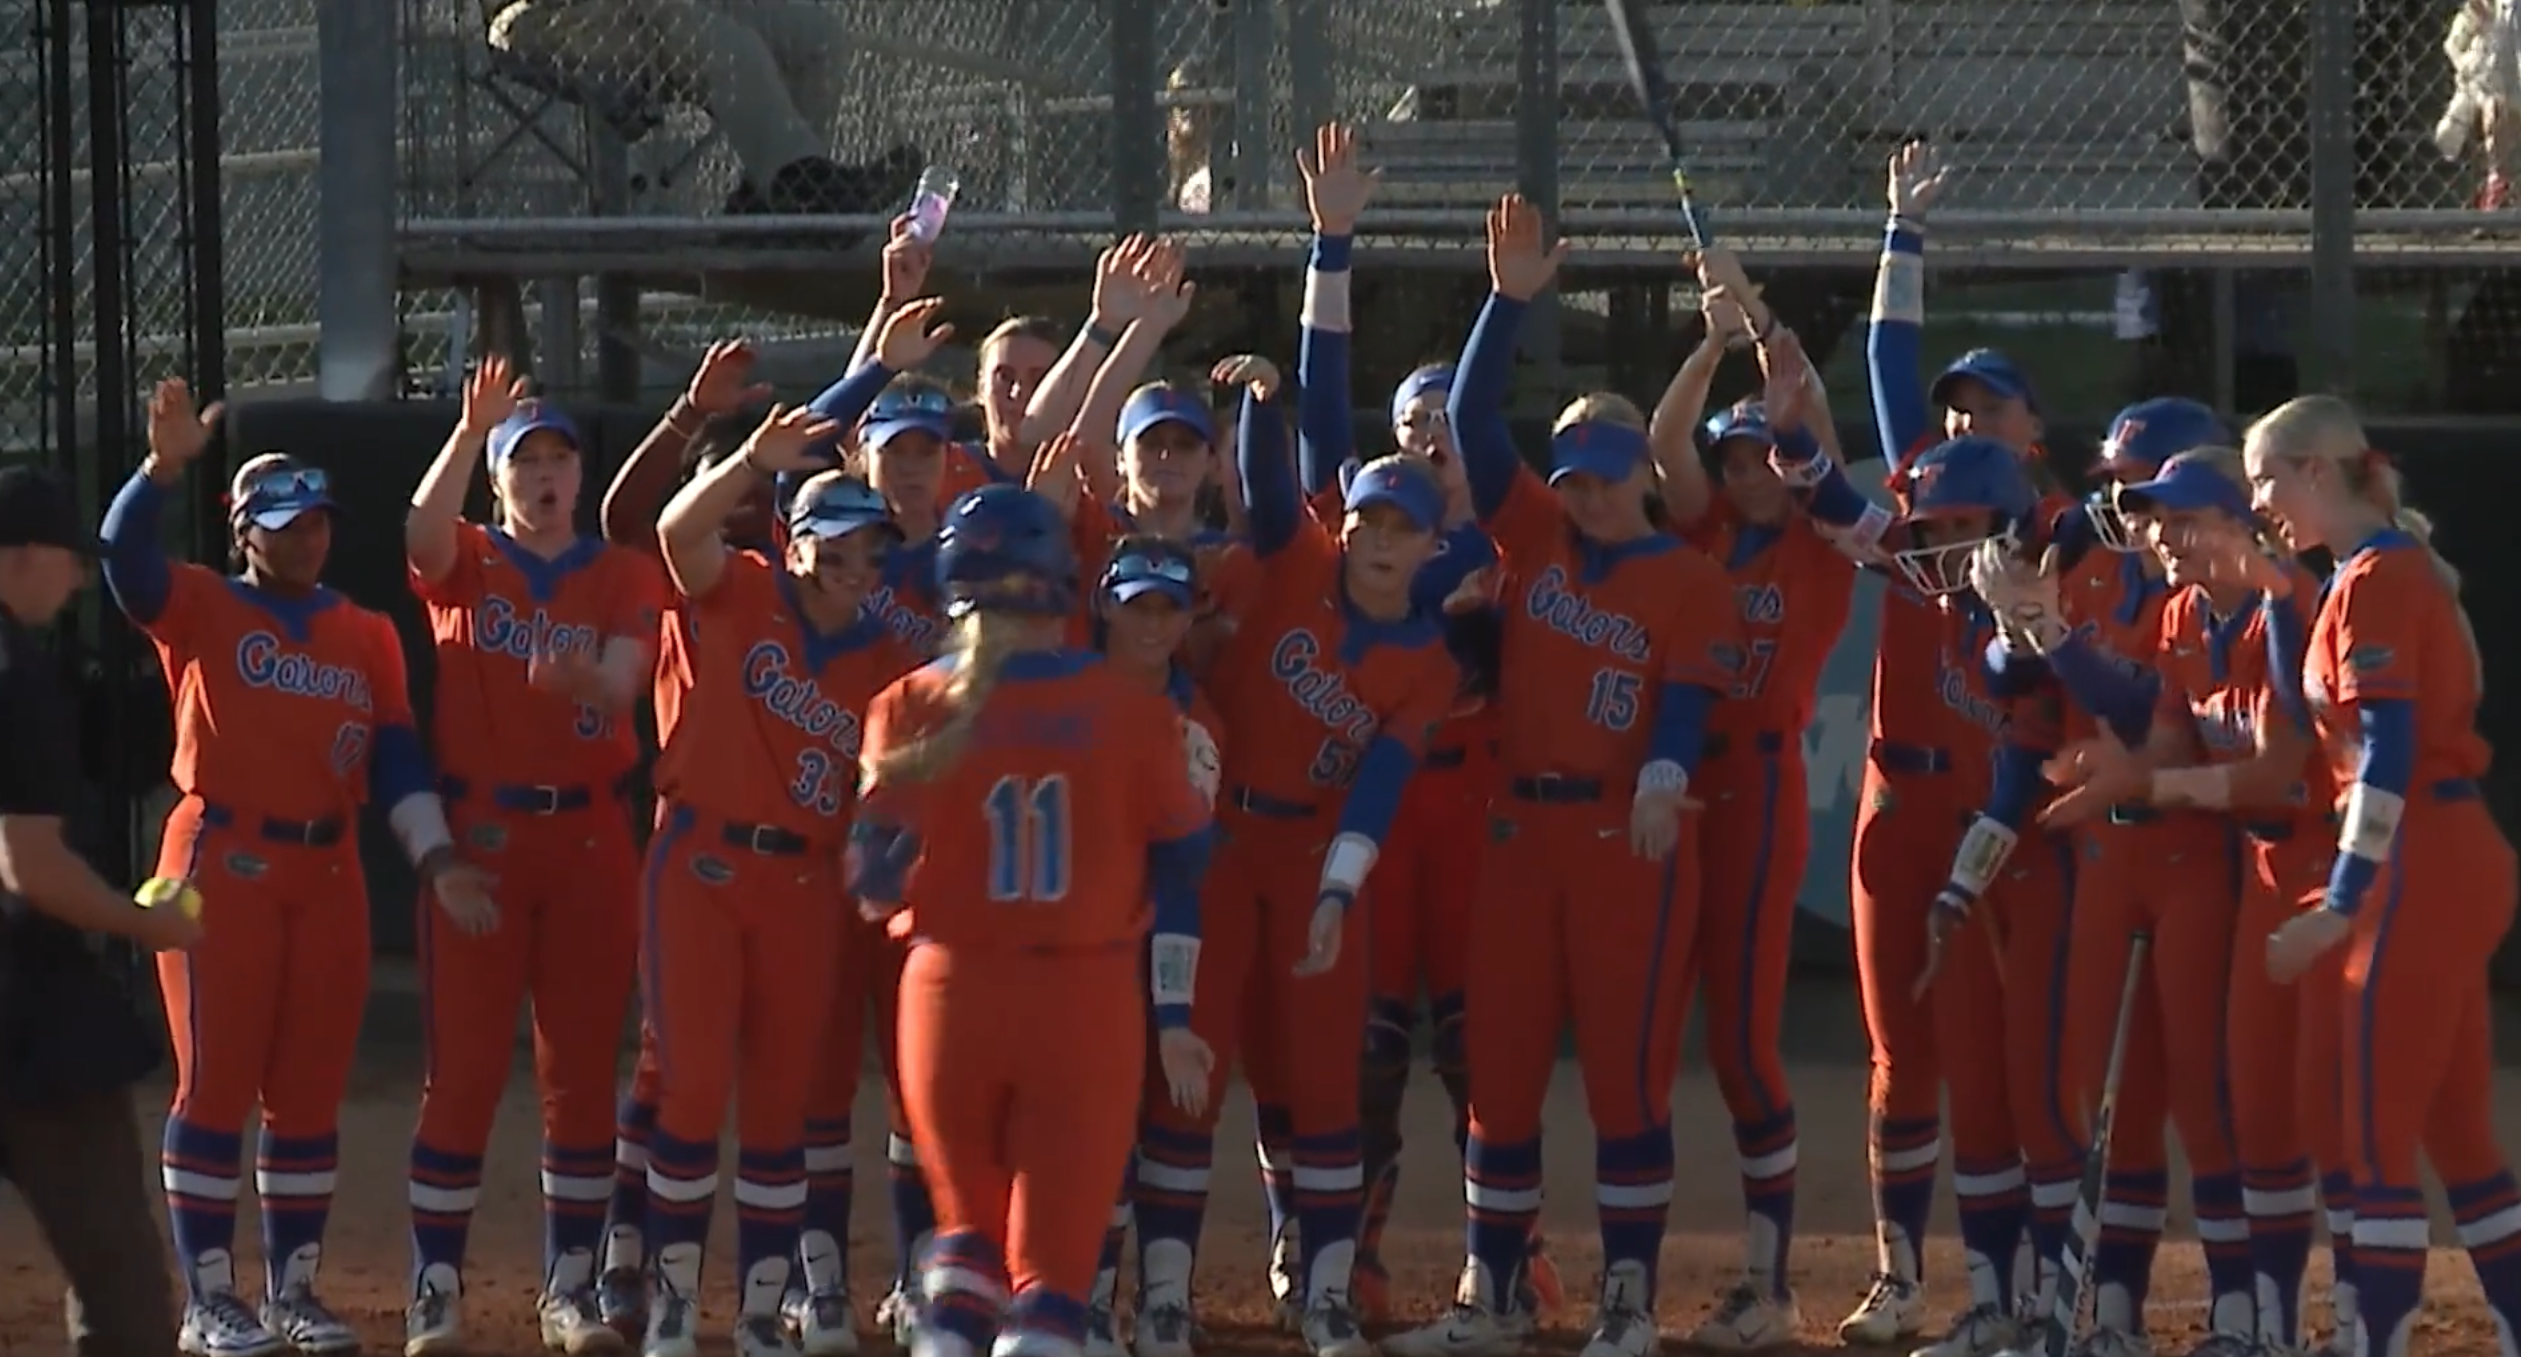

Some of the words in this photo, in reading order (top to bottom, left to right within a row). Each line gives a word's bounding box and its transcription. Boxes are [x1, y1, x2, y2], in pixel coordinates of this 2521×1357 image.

[475, 593, 598, 659] Gator
[1527, 563, 1652, 664] Gators
[1271, 627, 1377, 746] Gator
[1587, 666, 1643, 731] 15
[982, 772, 1073, 903] 11
